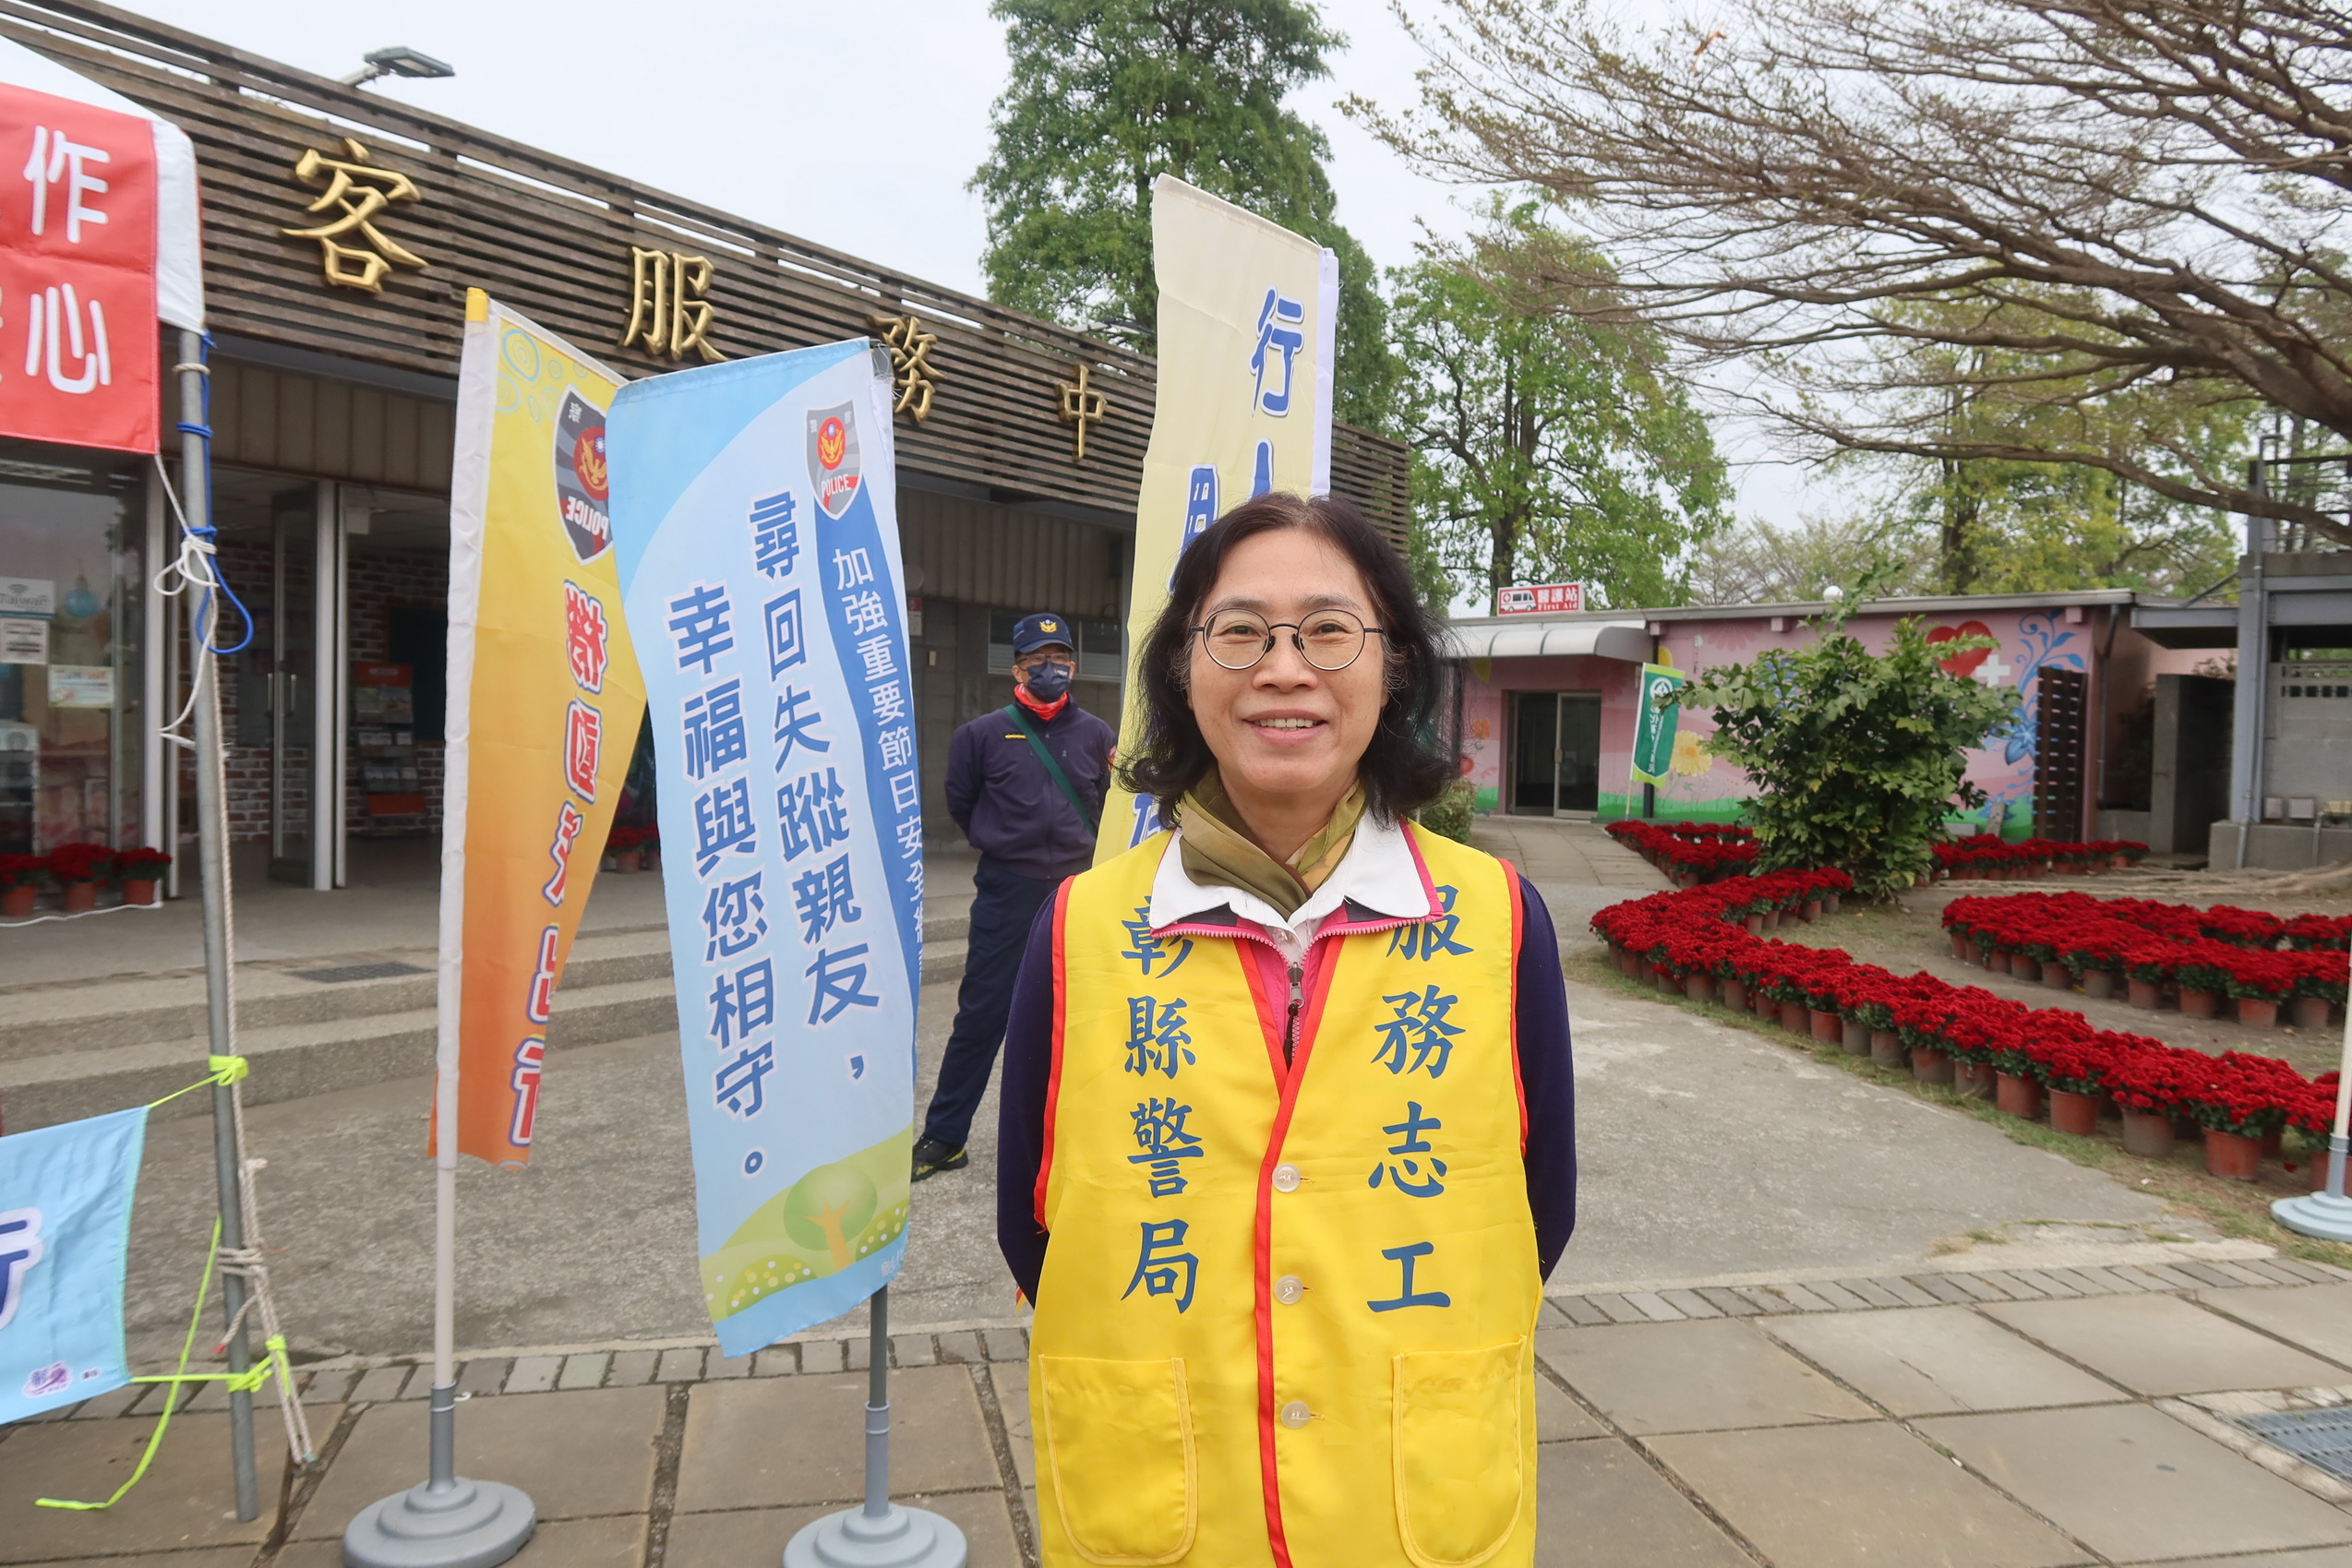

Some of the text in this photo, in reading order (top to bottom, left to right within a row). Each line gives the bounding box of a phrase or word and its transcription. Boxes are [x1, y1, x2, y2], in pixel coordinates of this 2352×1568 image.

[23, 126, 110, 243] 作
[0, 283, 112, 394] 心
[281, 137, 1108, 461] 客服務中
[821, 473, 851, 498] POLICE
[1538, 601, 1578, 611] First Aid
[832, 546, 922, 986] 加強重要節日安全
[1121, 895, 1205, 1314] 彰縣警局
[1367, 884, 1474, 1313] 服務志工
